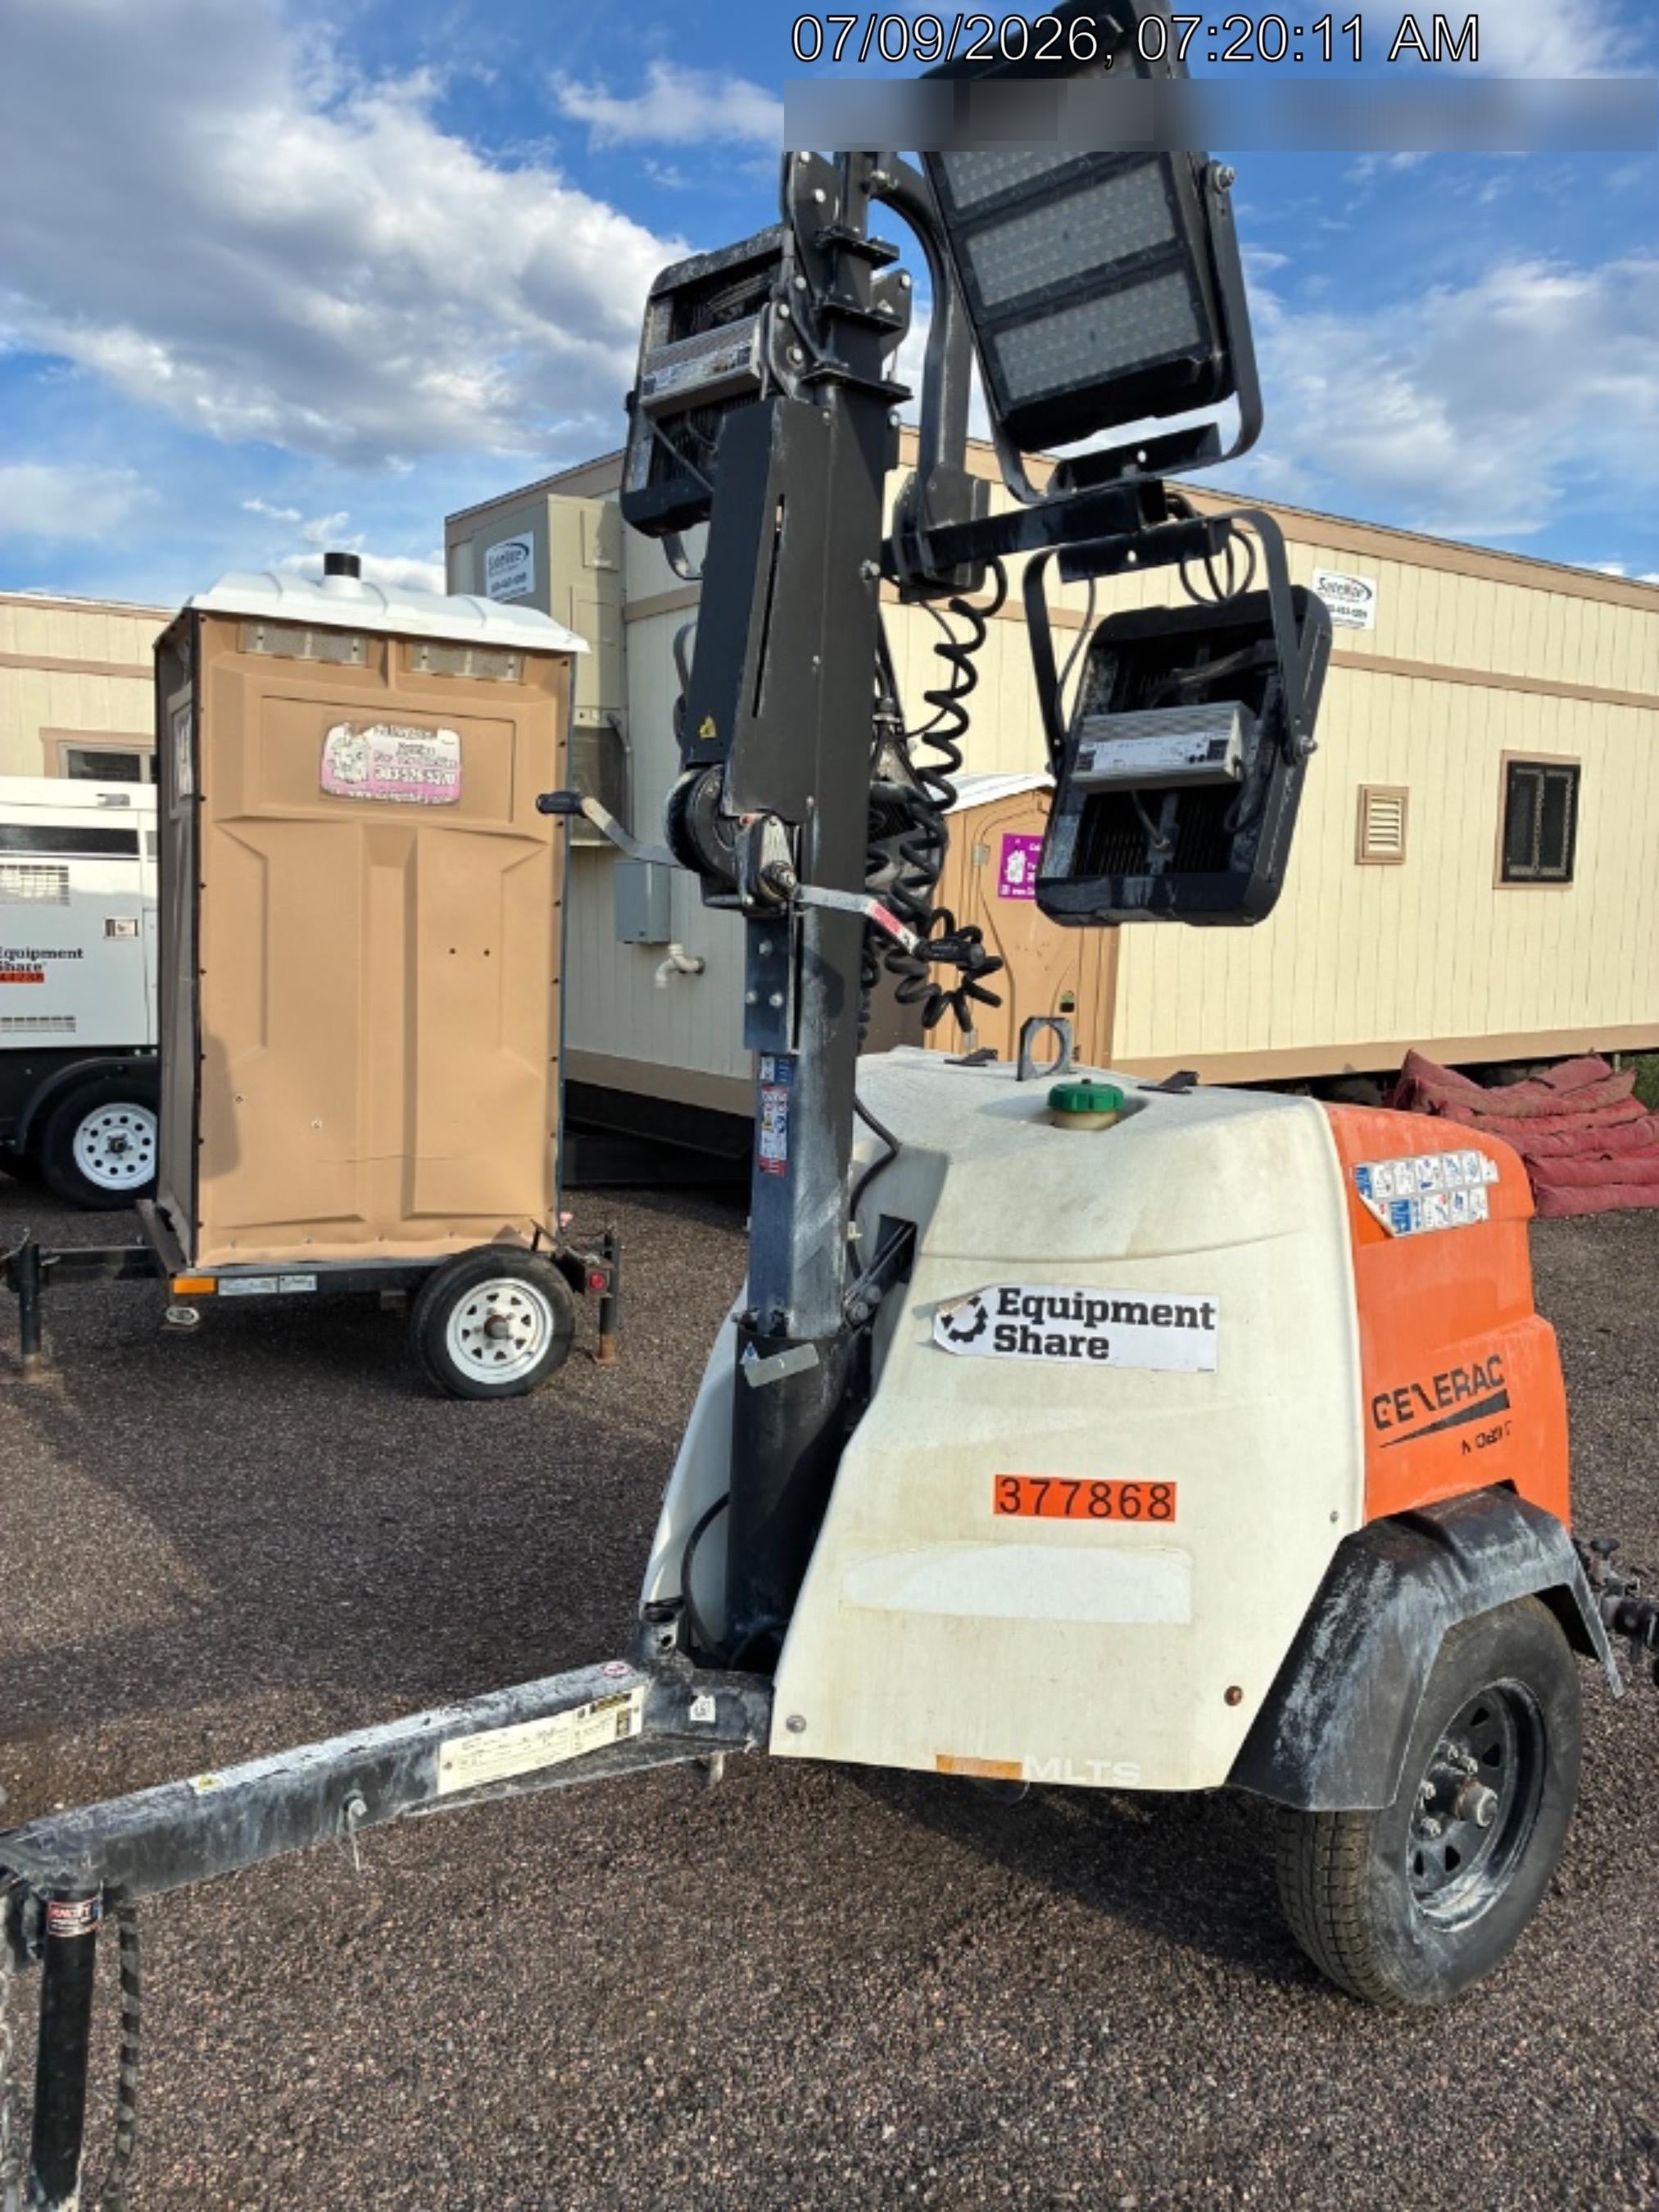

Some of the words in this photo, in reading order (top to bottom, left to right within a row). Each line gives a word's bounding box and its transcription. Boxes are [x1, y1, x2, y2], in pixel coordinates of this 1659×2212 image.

[0, 961, 42, 972] hare
[997, 1287, 1216, 1330] Equipment
[993, 1324, 1109, 1360] Share
[999, 1476, 1171, 1520] 377868
[1025, 1756, 1141, 1786] MLTS
